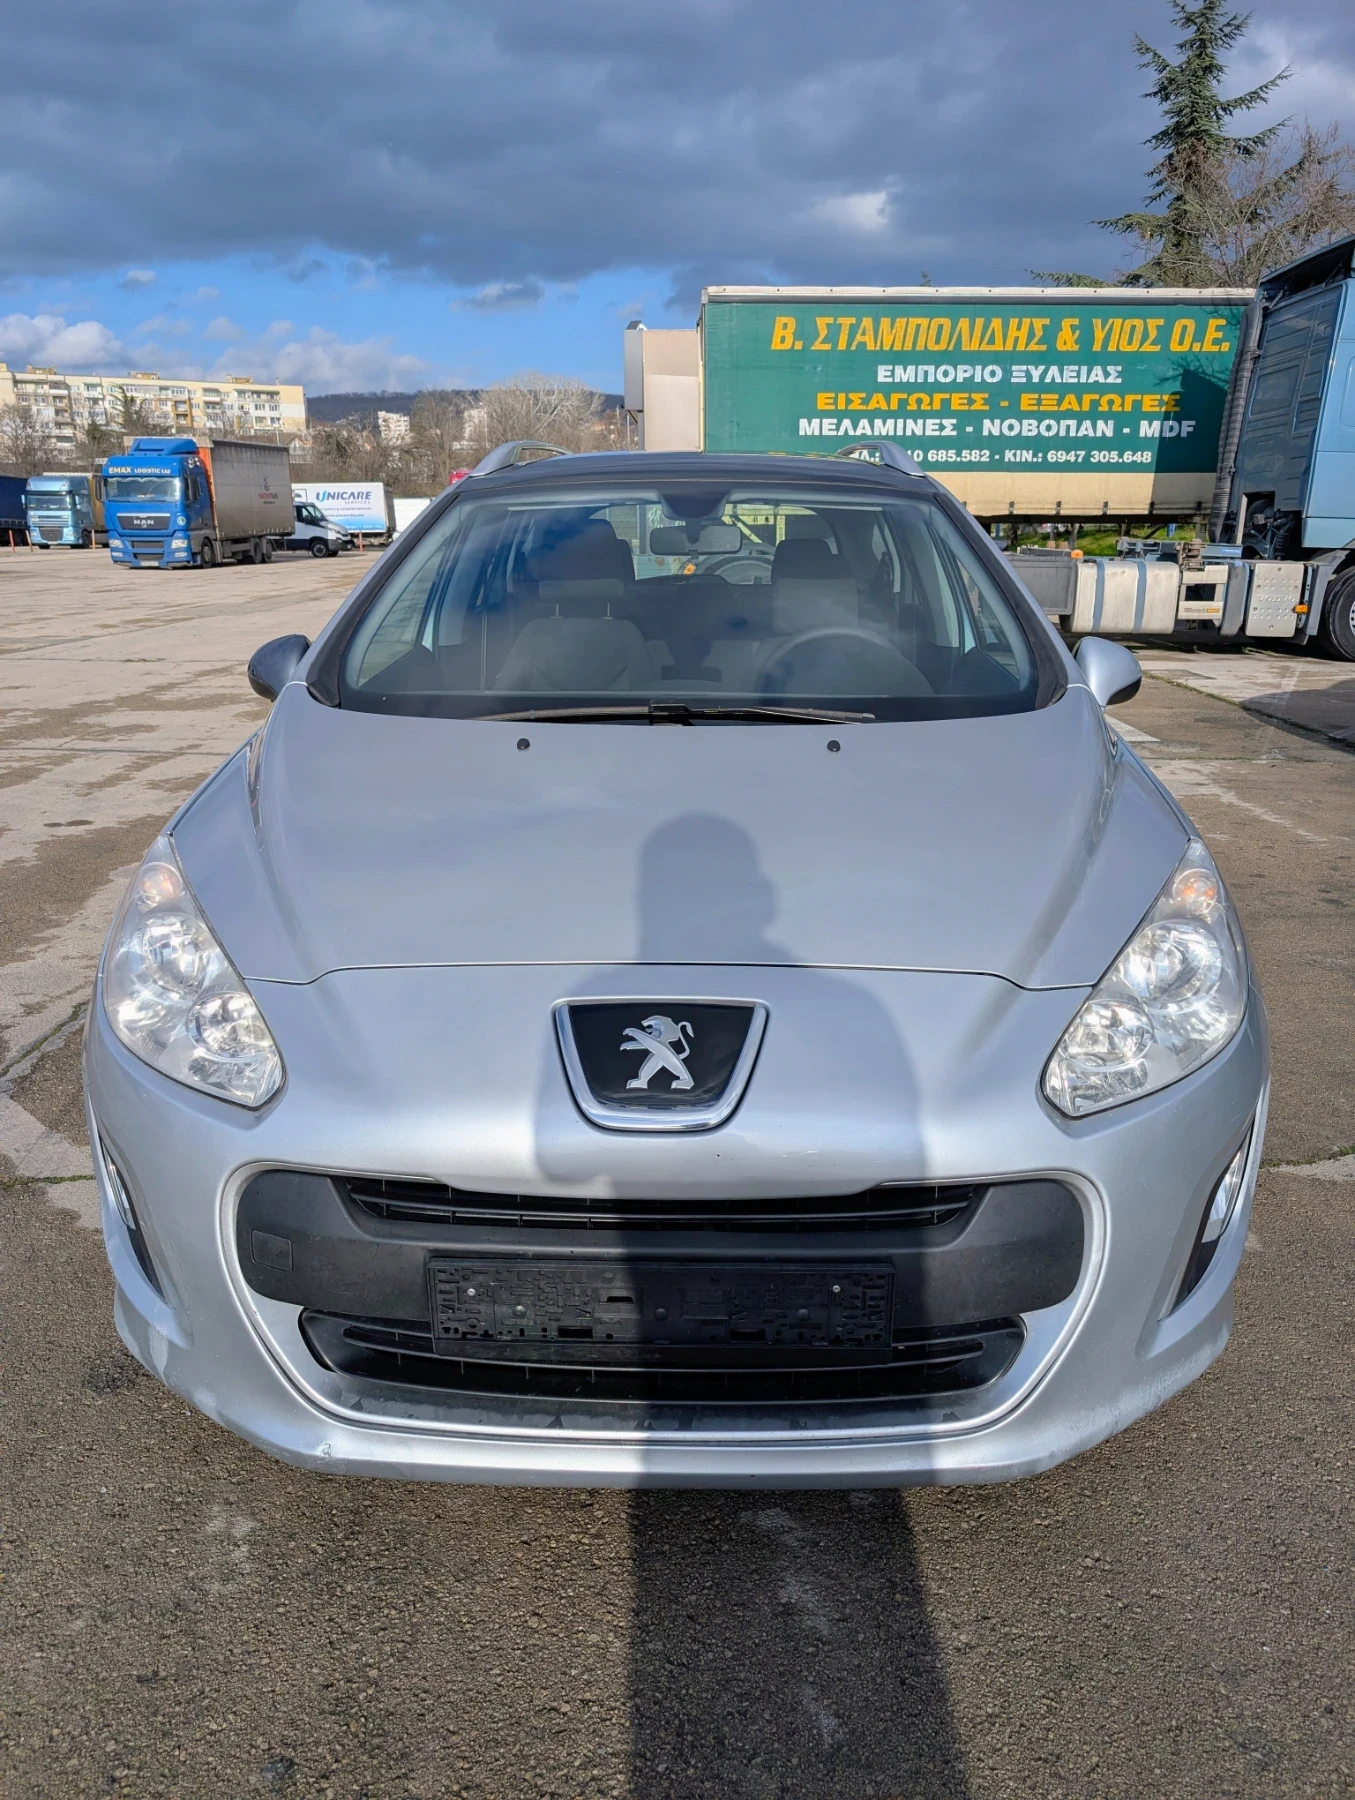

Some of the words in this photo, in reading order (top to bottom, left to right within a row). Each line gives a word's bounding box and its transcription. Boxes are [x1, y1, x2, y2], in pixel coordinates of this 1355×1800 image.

[771, 316, 803, 351] Β.
[810, 316, 1050, 352] ΣΤΑΜΠΟΛΙΔΗΣ
[1056, 318, 1080, 352] &
[1092, 318, 1164, 353] ΥΙΟΣ
[1169, 318, 1230, 353] Ο.Ε.
[876, 364, 1003, 384] ΕΜΠΟΡΙΟ
[1010, 364, 1123, 384] ΞΥΛΕΙΑΣ
[816, 392, 990, 411] ΕΙΣΑΓΩΓΕΣ
[1019, 393, 1180, 412] ΕΞΑΓΩΓΕΣ
[798, 418, 958, 437] ΜΕΛΑΜΙΝΕΣ
[982, 418, 1115, 438] ΝΟΒΟΠΑΝ
[1139, 420, 1196, 438] MDF
[927, 449, 991, 463] 685.582
[1004, 449, 1043, 463] ΚΙΝ.:
[1046, 449, 1086, 463] 6947
[1089, 450, 1152, 464] 305.648
[108, 466, 131, 474] EMAX
[315, 490, 372, 502] UNICARE
